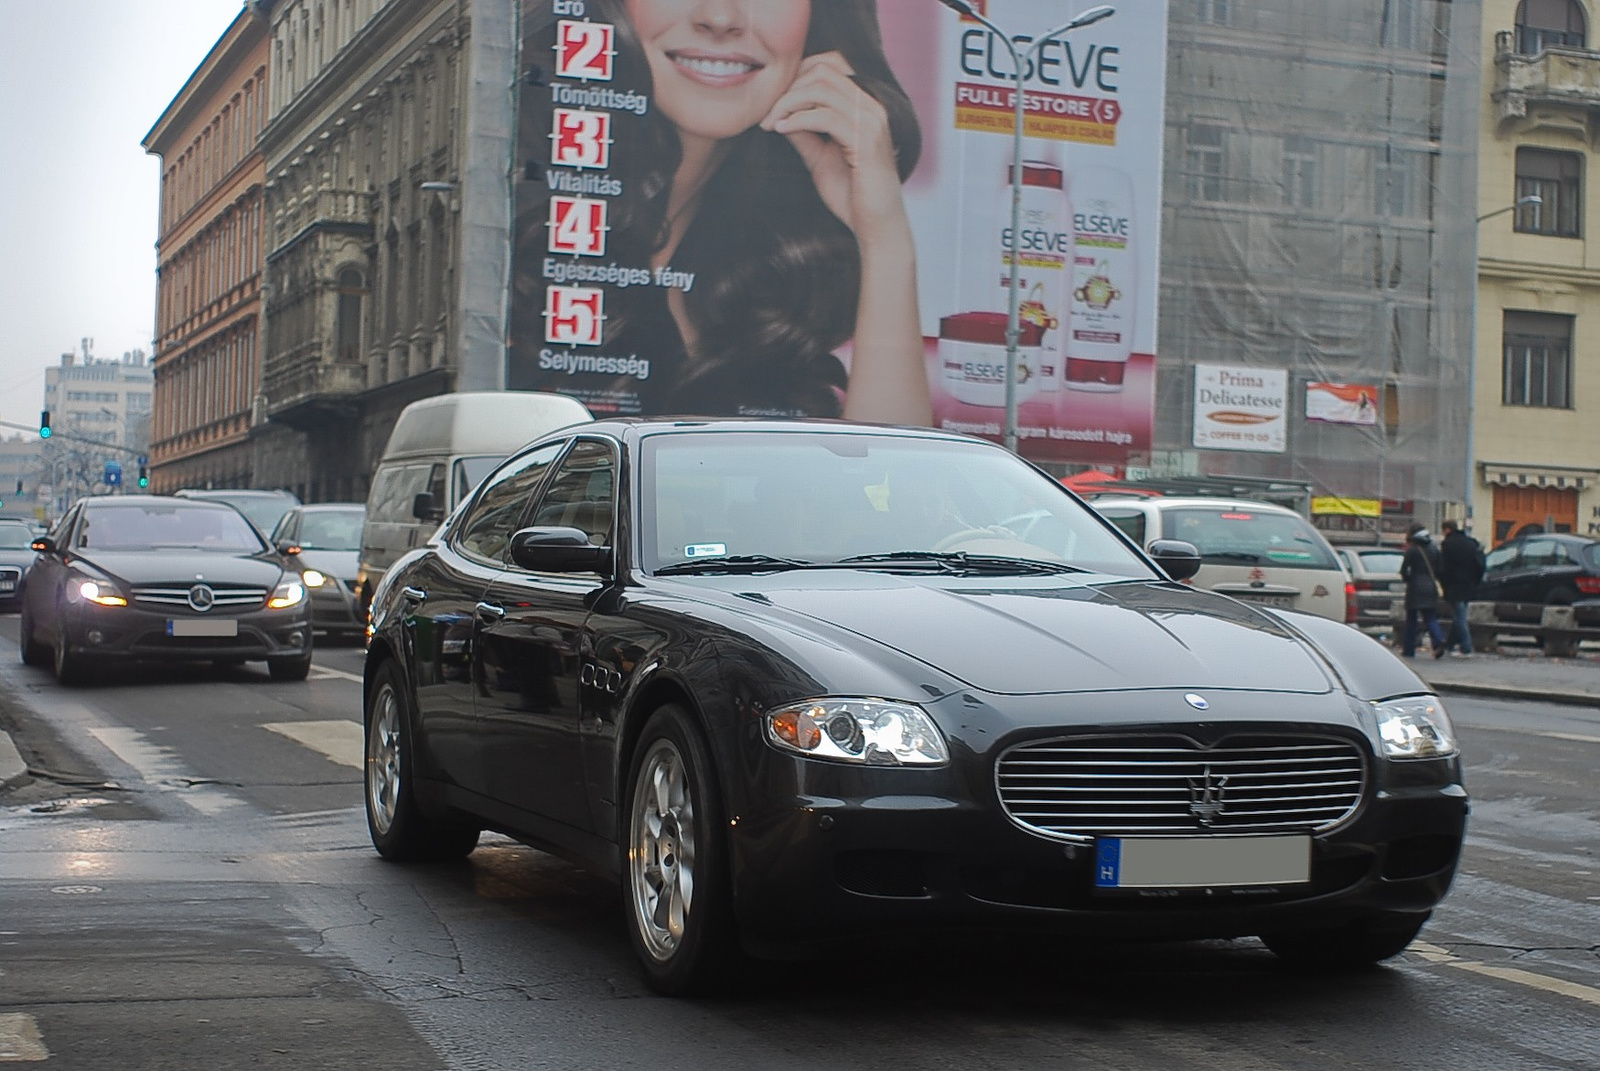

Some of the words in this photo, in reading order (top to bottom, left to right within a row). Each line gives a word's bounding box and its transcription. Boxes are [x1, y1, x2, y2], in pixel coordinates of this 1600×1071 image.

[564, 25, 605, 76] 2
[550, 83, 648, 115] Tömöttség
[957, 87, 1003, 107] FULL
[1008, 93, 1090, 117] RESTORE
[561, 115, 600, 165] 3
[546, 170, 622, 196] Vitalitás
[557, 199, 596, 252] 4
[543, 258, 650, 288] Egészséges
[655, 266, 695, 292] fény
[556, 290, 596, 342] 5
[539, 349, 650, 380] Selymesség
[1219, 371, 1264, 388] Prima
[1201, 389, 1283, 409] Delicatesse
